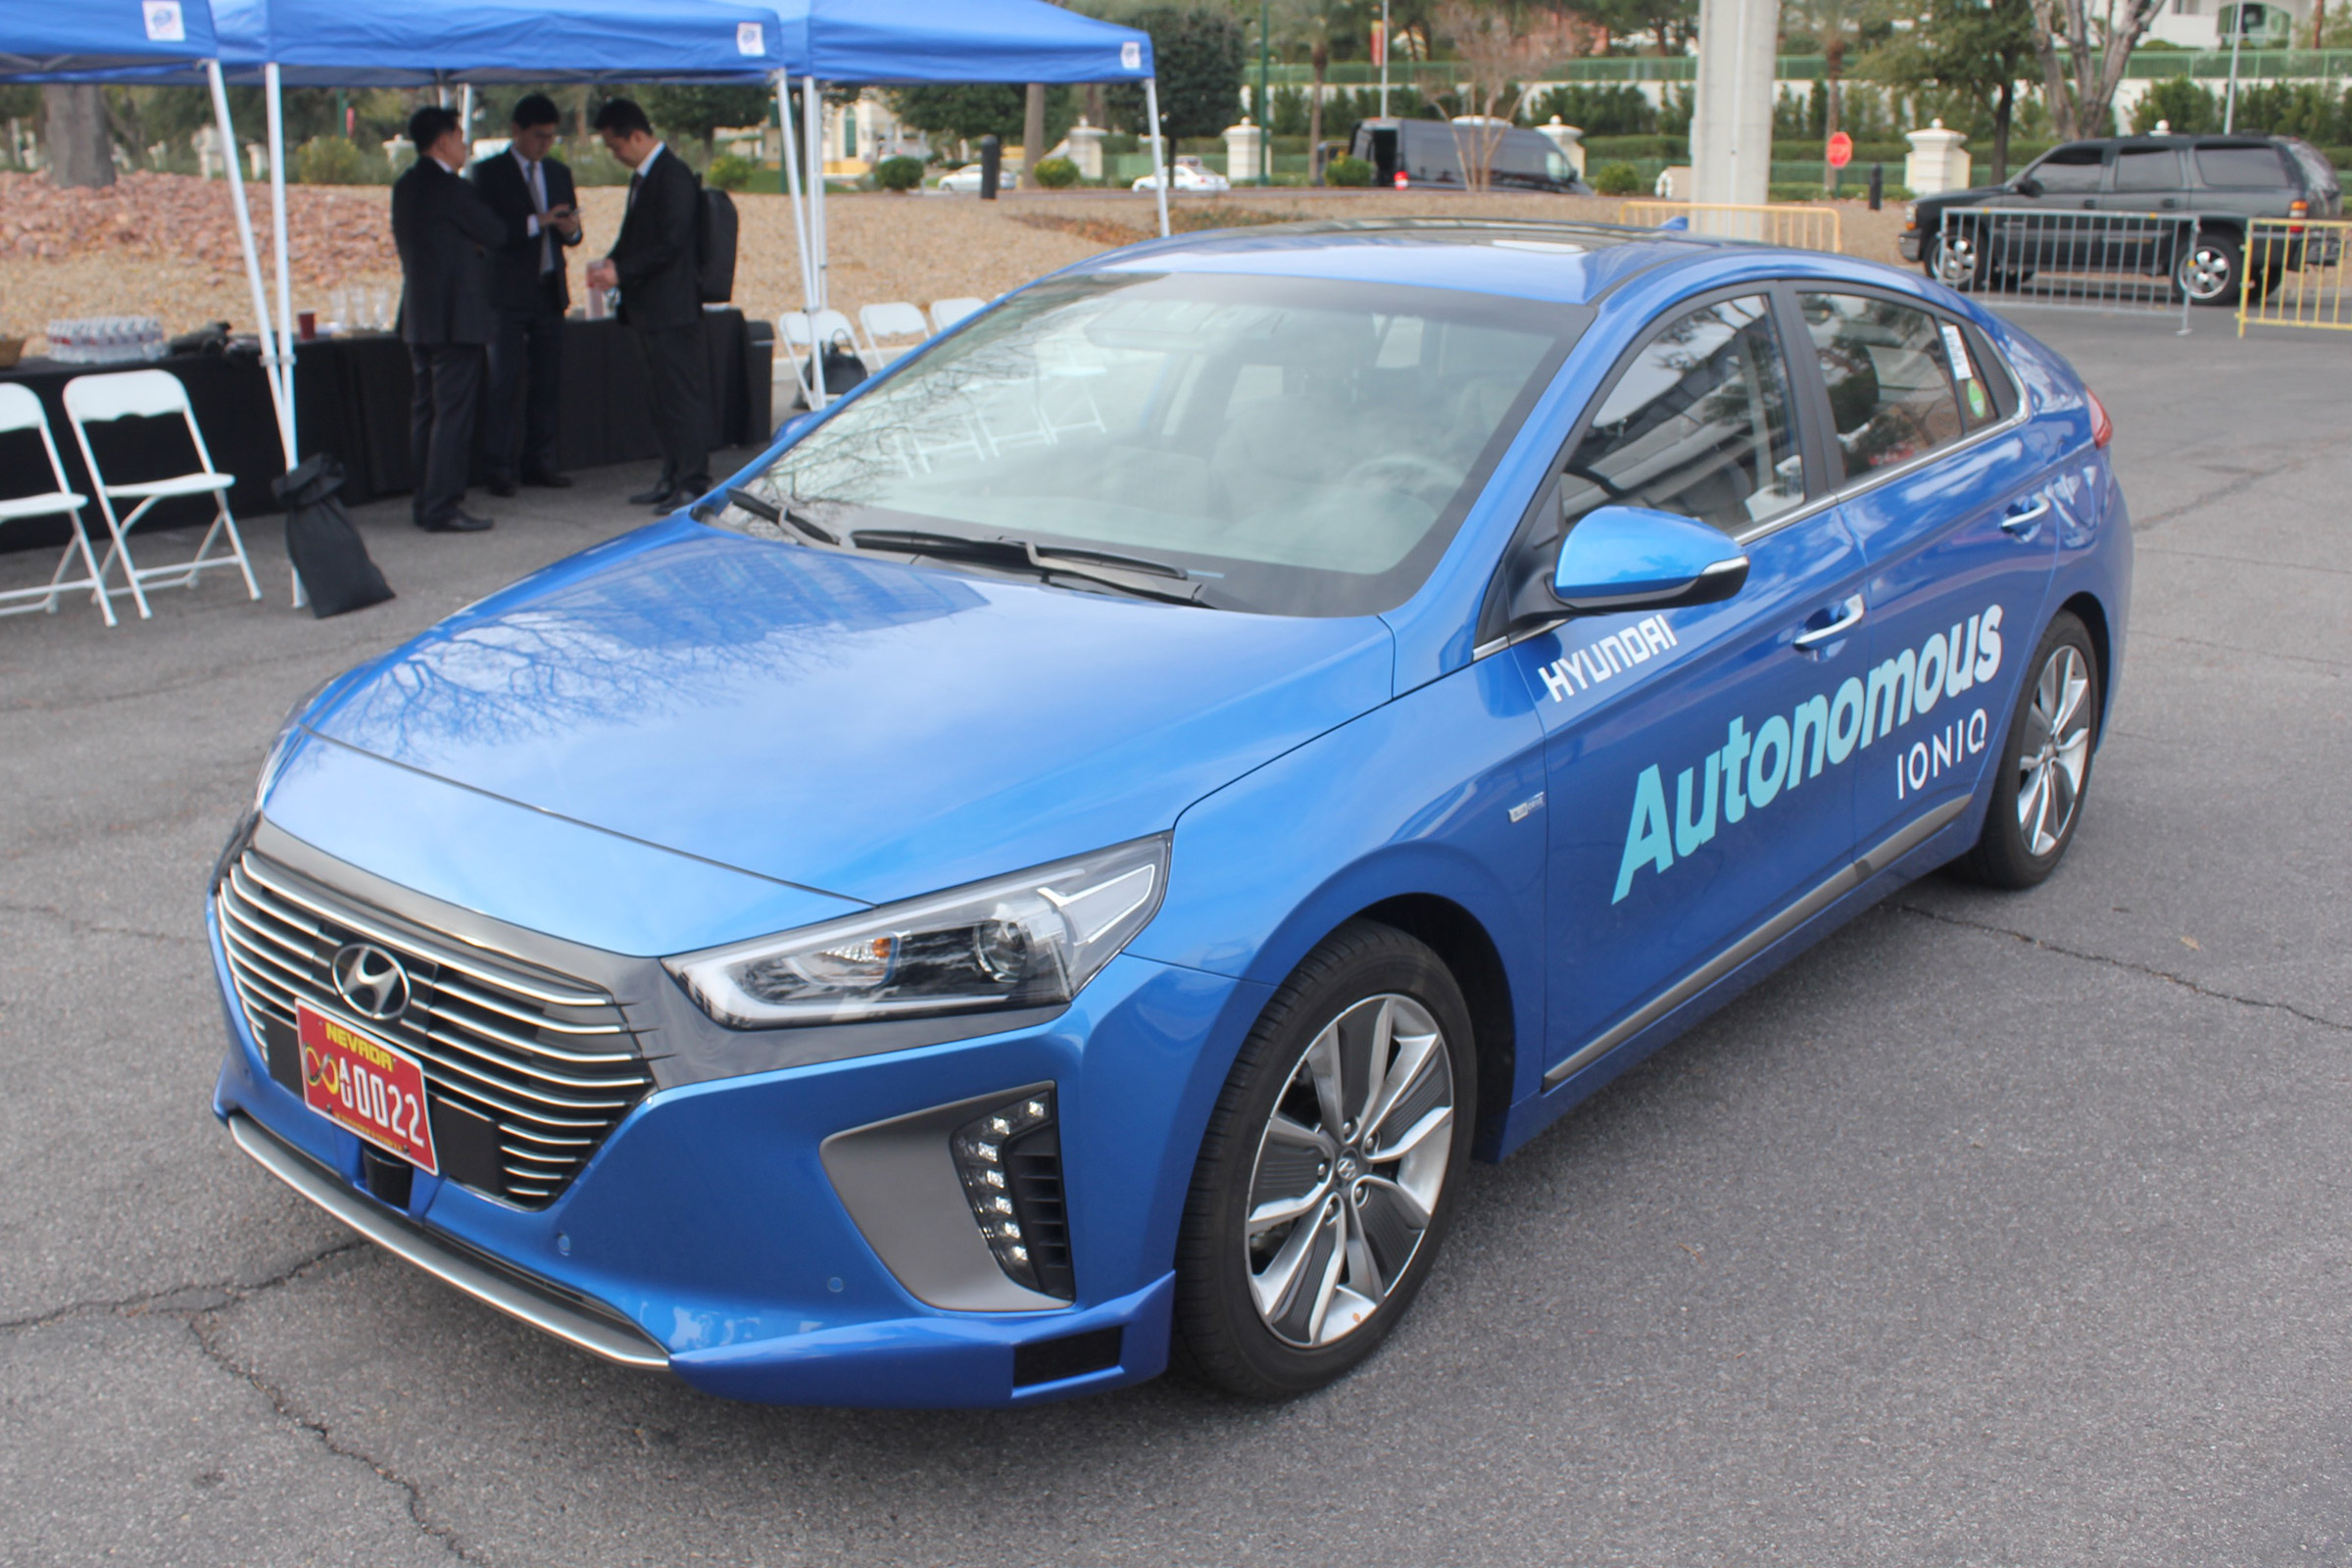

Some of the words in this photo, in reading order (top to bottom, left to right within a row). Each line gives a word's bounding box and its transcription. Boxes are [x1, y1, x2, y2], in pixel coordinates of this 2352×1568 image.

[1538, 613, 1678, 703] HYUNDAI
[1611, 604, 2003, 905] Autonomous
[1897, 708, 1986, 800] IONIQ
[325, 1021, 394, 1072] NEVADA
